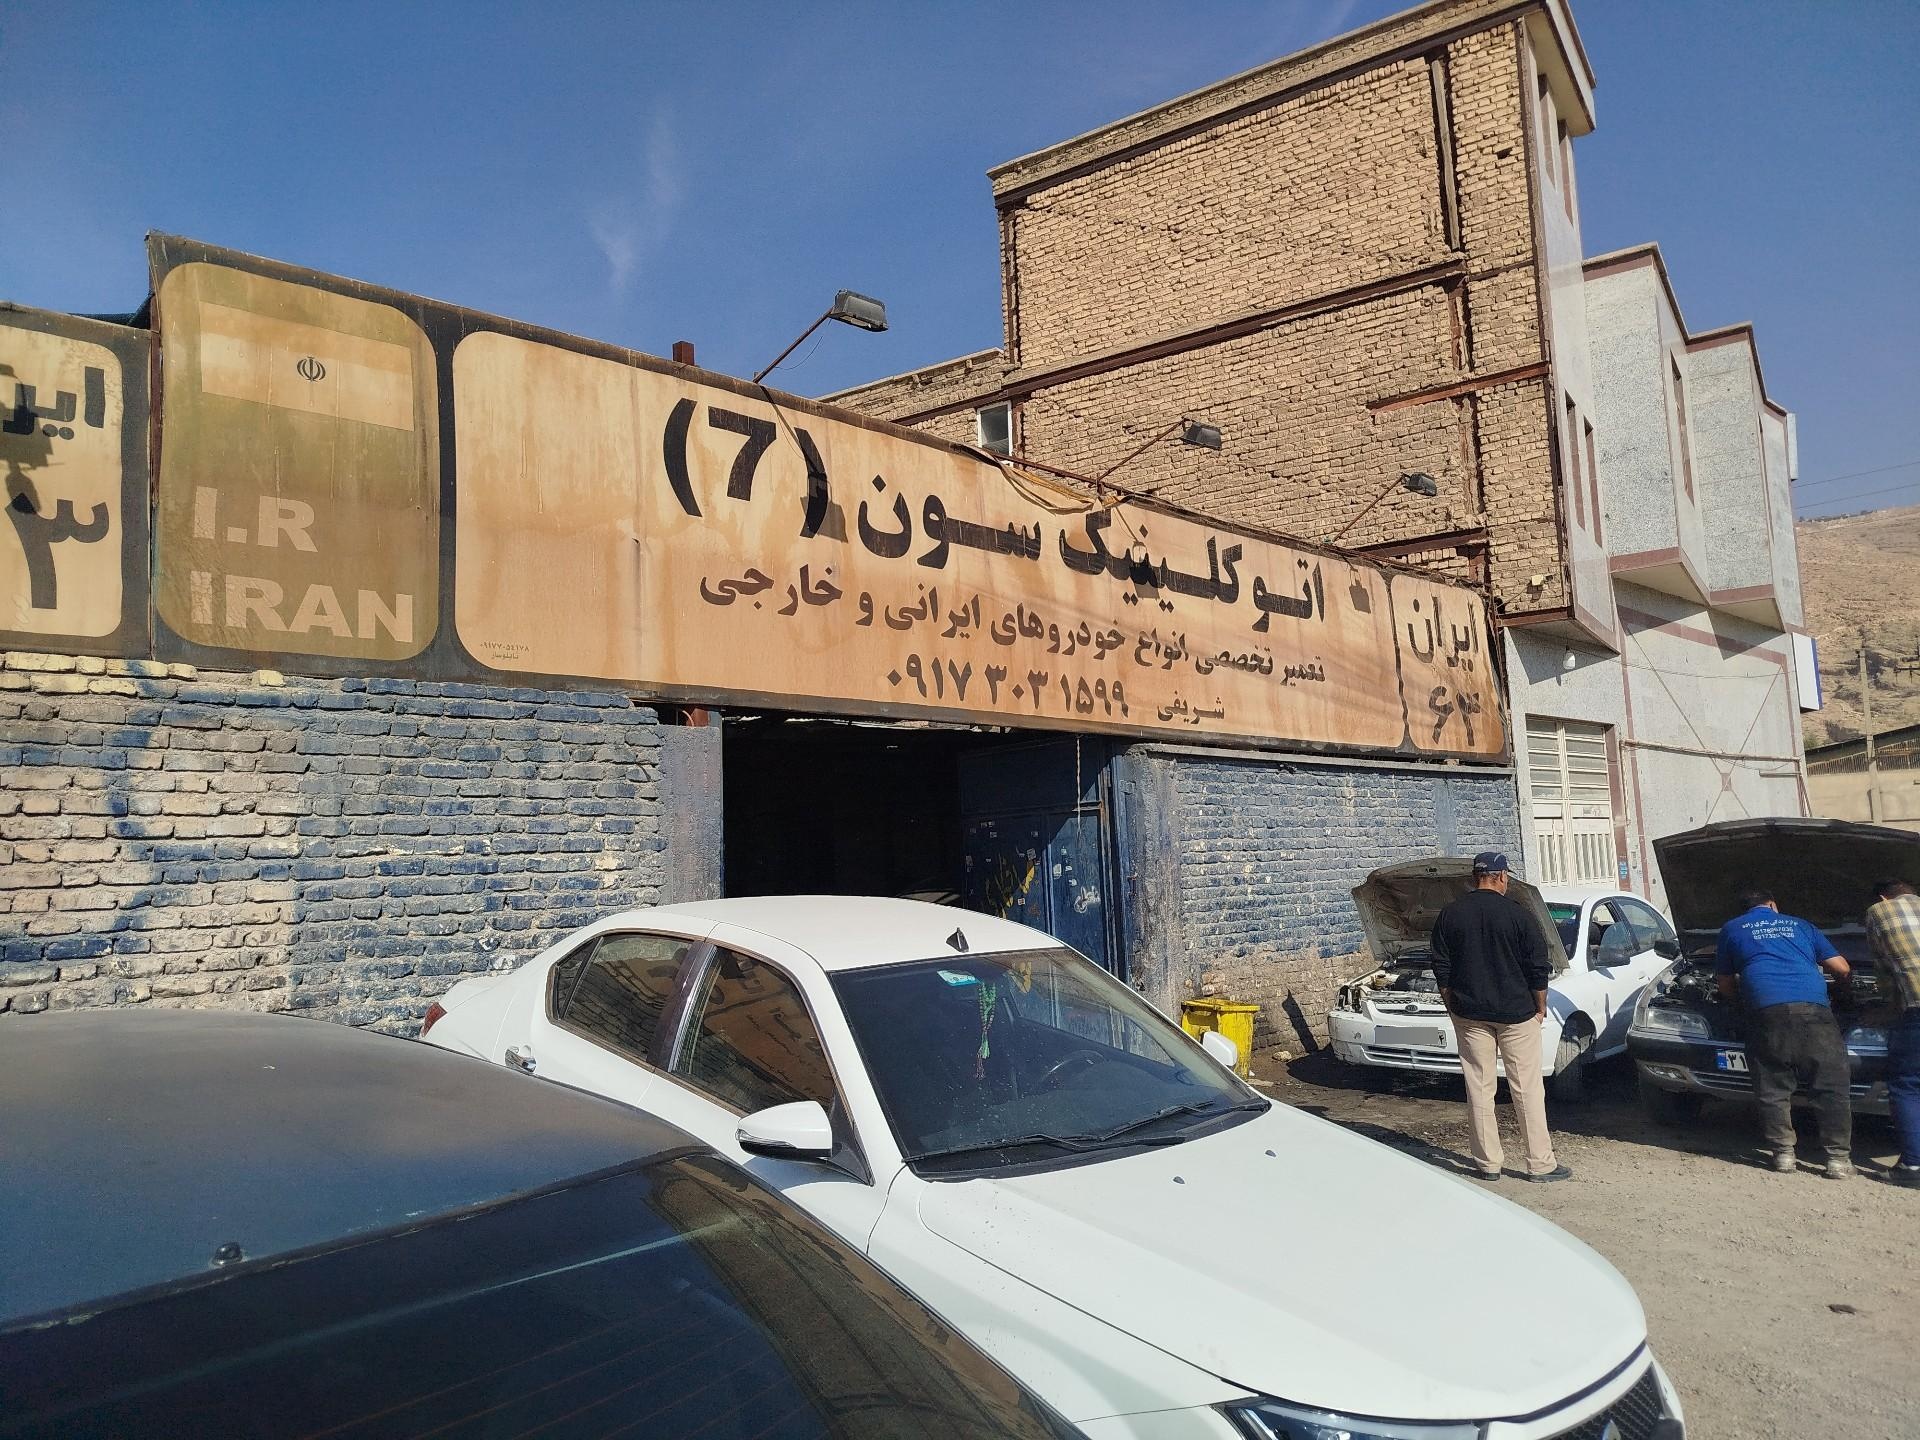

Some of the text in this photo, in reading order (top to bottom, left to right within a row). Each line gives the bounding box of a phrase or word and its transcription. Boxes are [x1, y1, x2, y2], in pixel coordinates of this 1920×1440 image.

[194, 486, 318, 553] I.R
[663, 397, 1325, 633] اتو کلینیک سون (7)
[190, 571, 414, 643] IRAN
[700, 563, 1326, 687] تعمیر تخصصی انواع خودروهای ایرانی و خارجی
[1407, 595, 1479, 673] ایران
[887, 653, 1130, 718] ۰۹۱۷ ۳۰۳ ۱۵۹۹
[1156, 690, 1225, 724] شریفی
